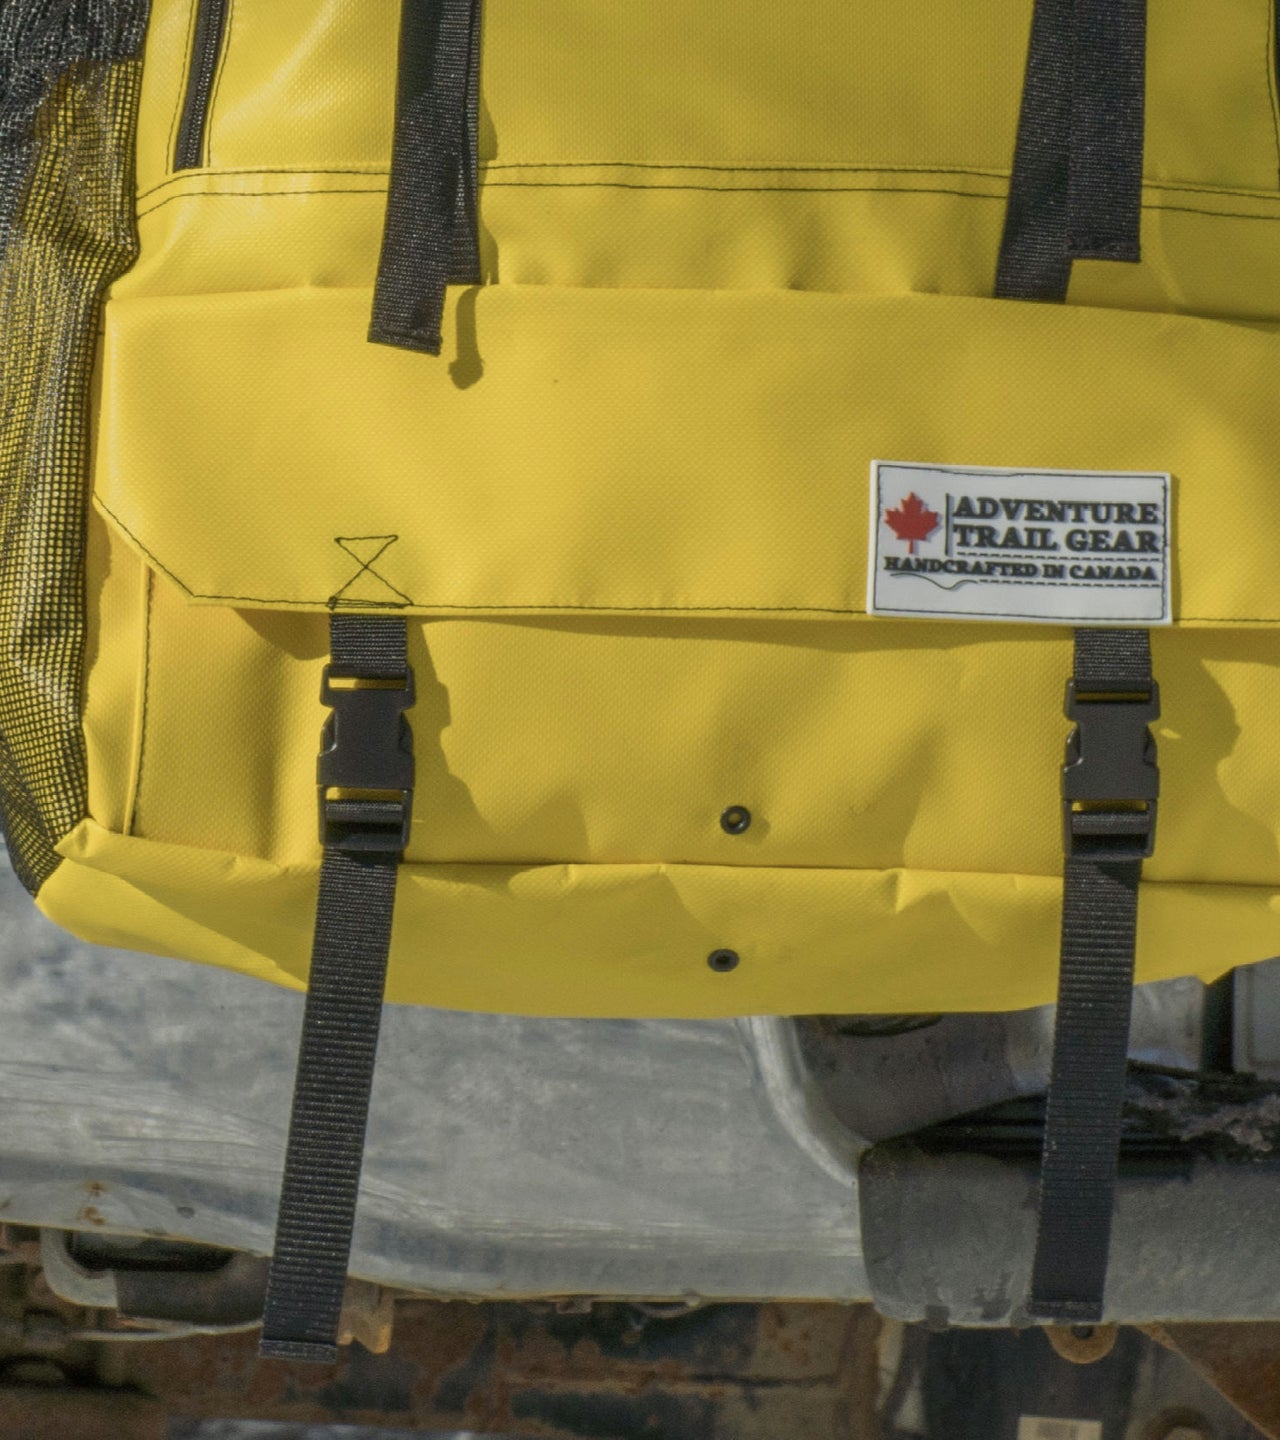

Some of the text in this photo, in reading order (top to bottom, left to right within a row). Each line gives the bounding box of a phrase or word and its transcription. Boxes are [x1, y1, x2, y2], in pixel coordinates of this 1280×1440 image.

[953, 496, 1158, 525] ADVENTURE
[953, 524, 1160, 554] TRAIL GEAR
[884, 556, 1156, 580] HANDCRAFTED IN CANADA
